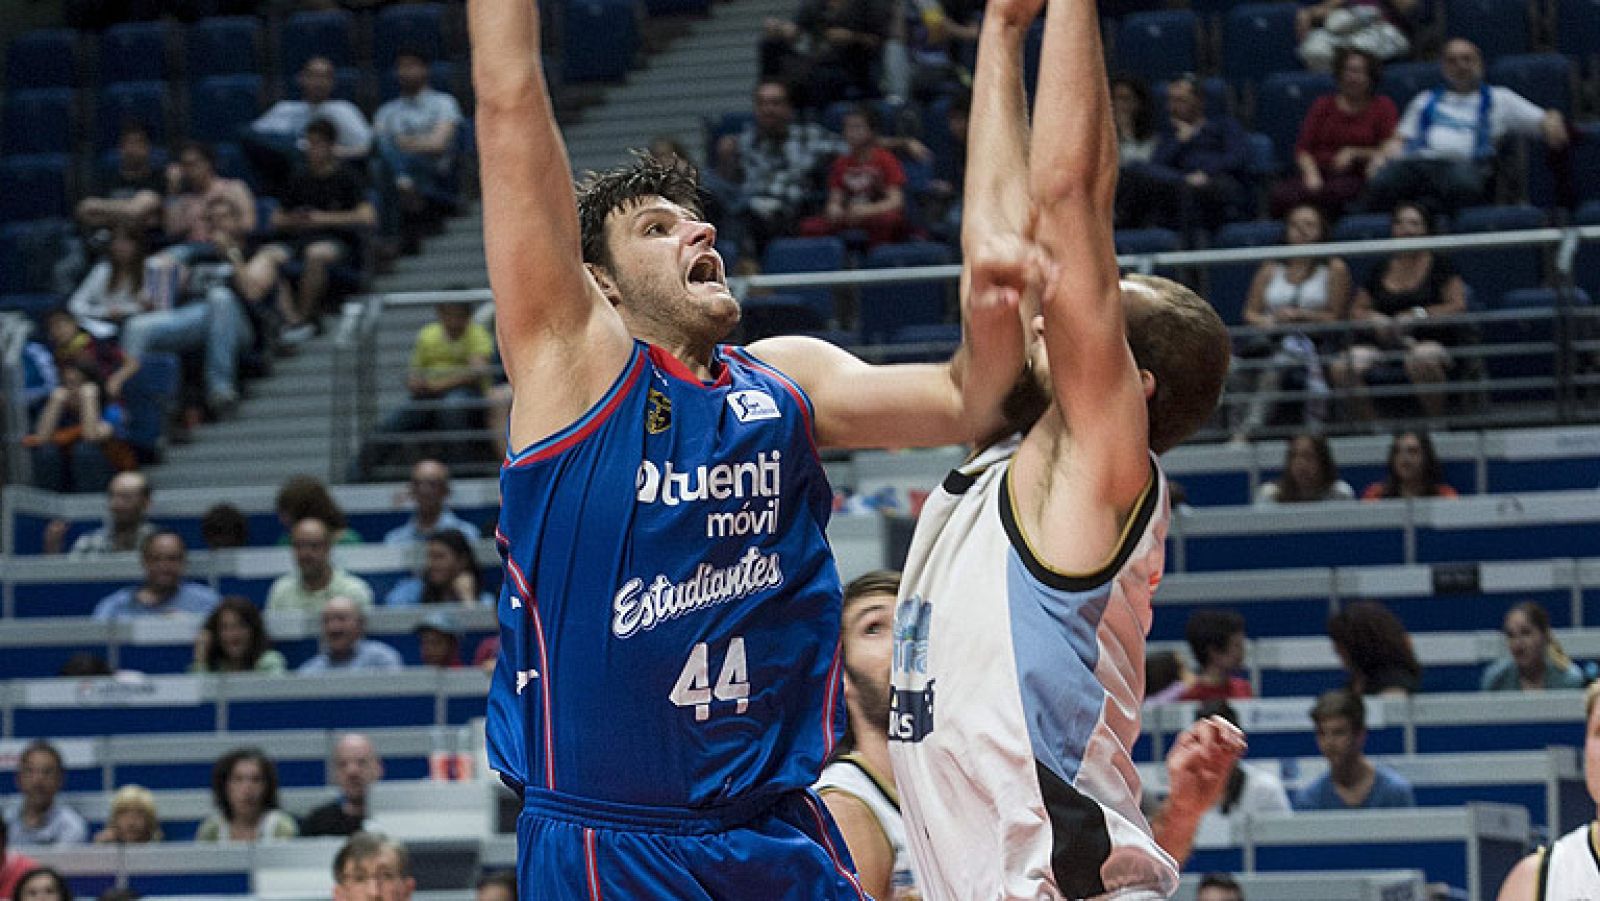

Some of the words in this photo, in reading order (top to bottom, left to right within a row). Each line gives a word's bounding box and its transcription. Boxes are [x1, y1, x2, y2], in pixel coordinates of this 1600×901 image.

[662, 450, 781, 506] tuenti
[707, 499, 780, 538] móvil
[612, 546, 784, 639] Estudiantes
[669, 637, 751, 722] 44
